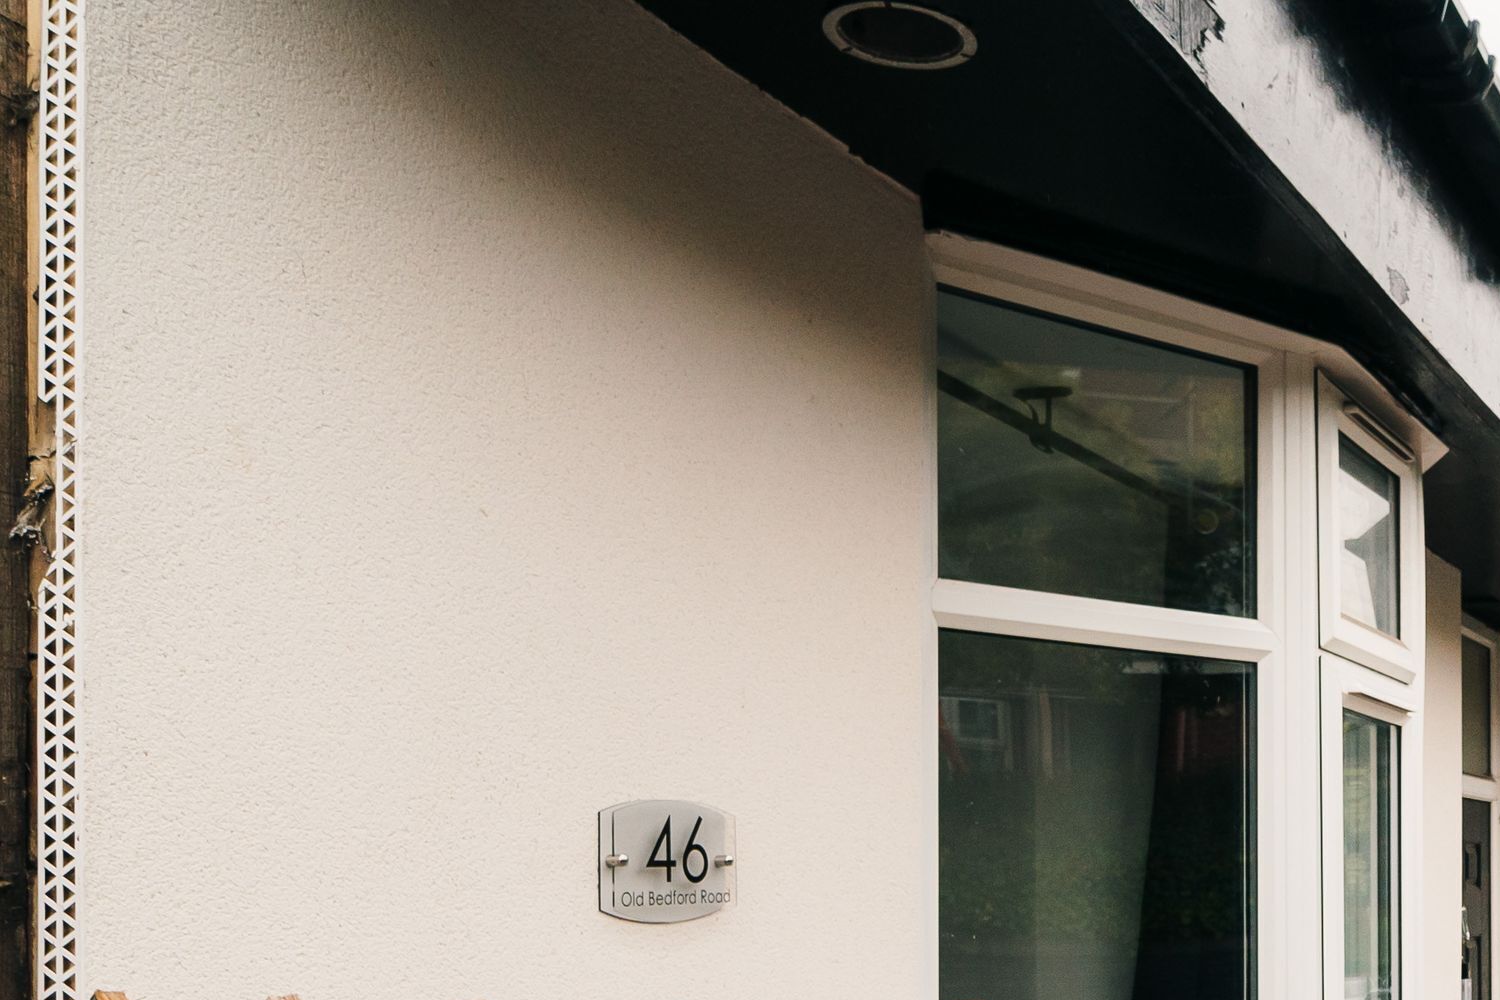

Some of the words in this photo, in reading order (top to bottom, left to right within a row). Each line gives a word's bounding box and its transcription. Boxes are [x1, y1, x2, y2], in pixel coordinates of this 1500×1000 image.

[646, 814, 708, 883] 46
[621, 891, 644, 907] Old
[648, 890, 697, 906] Bedford
[700, 889, 731, 904] Road
